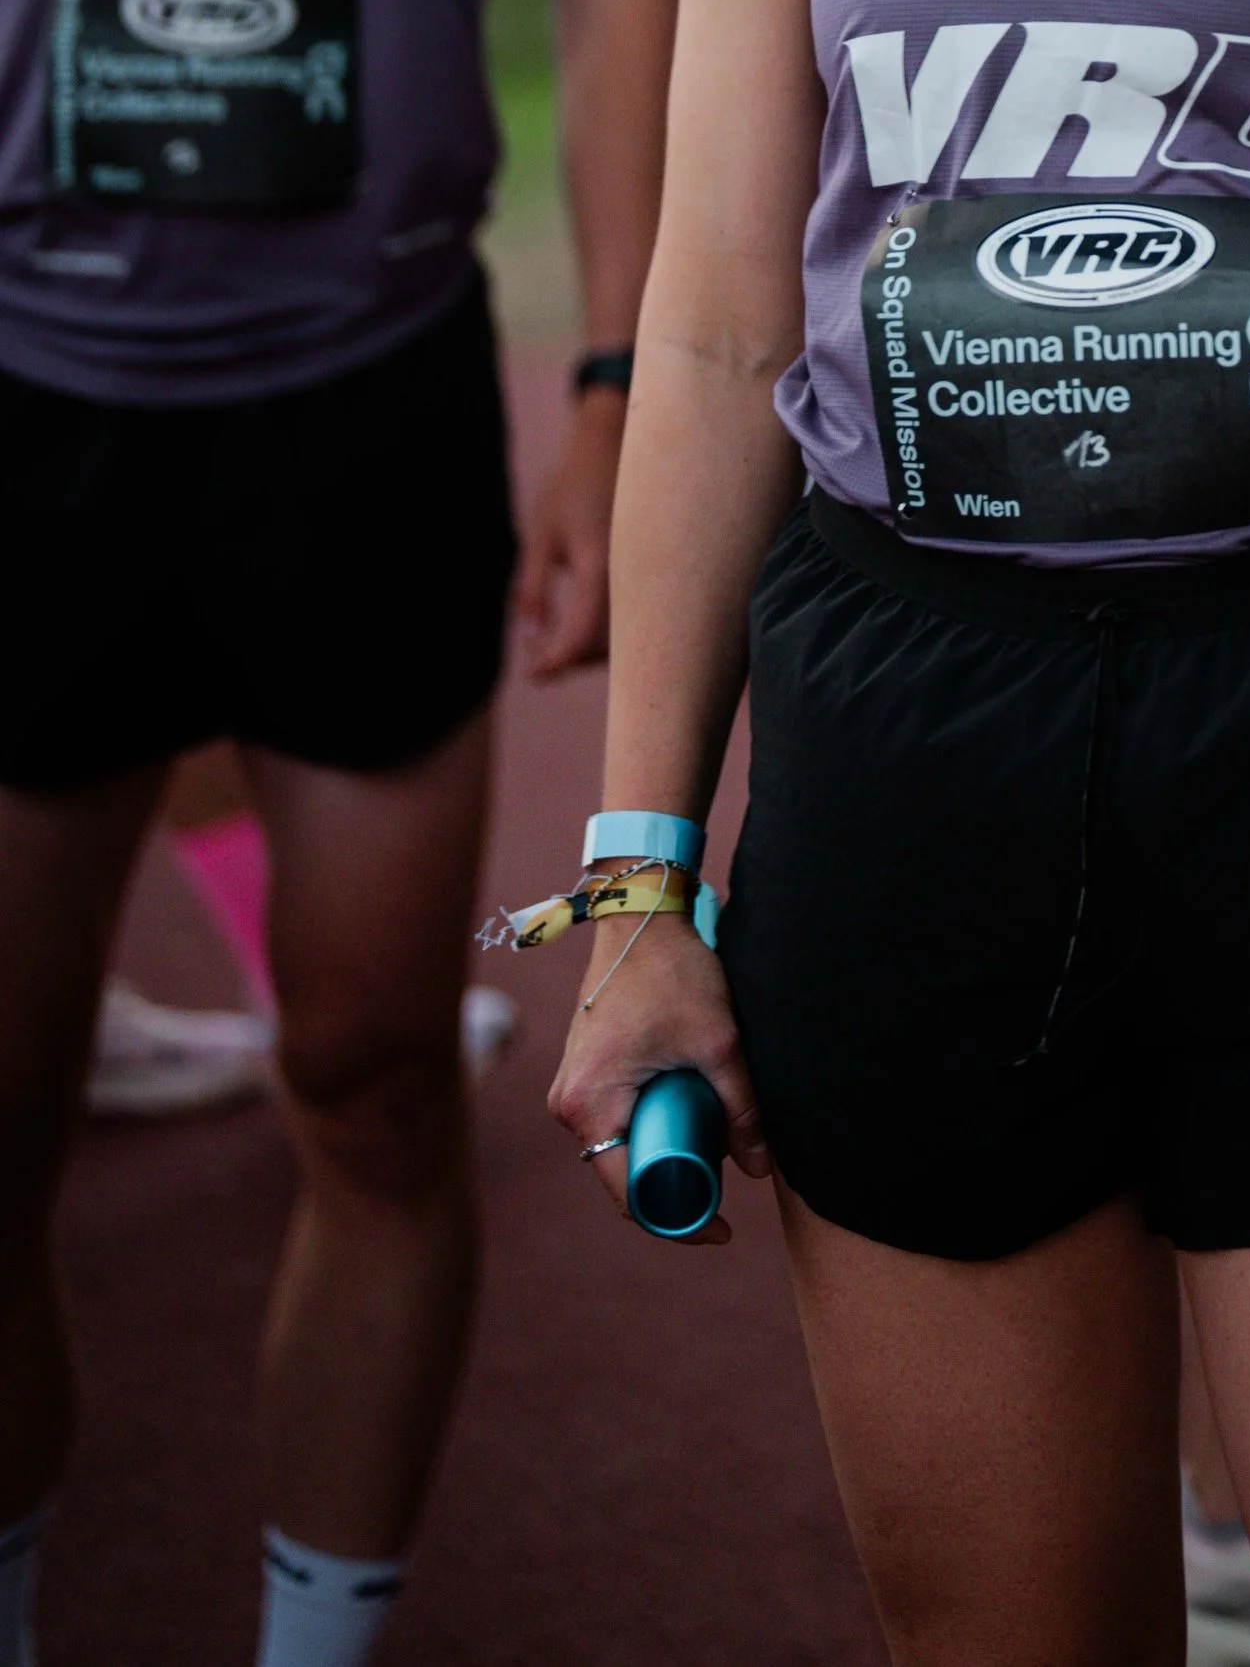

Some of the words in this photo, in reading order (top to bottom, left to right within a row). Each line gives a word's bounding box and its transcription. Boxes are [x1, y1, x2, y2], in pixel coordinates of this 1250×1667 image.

[884, 226, 917, 269] On
[1017, 227, 1183, 281] VRC
[876, 274, 916, 379] Squad
[922, 328, 1064, 366] Vienna
[1073, 323, 1241, 367] Running
[927, 377, 1131, 417] Collective
[891, 386, 927, 508] Mission
[1063, 430, 1111, 468] 13
[954, 493, 1021, 518] Wien
